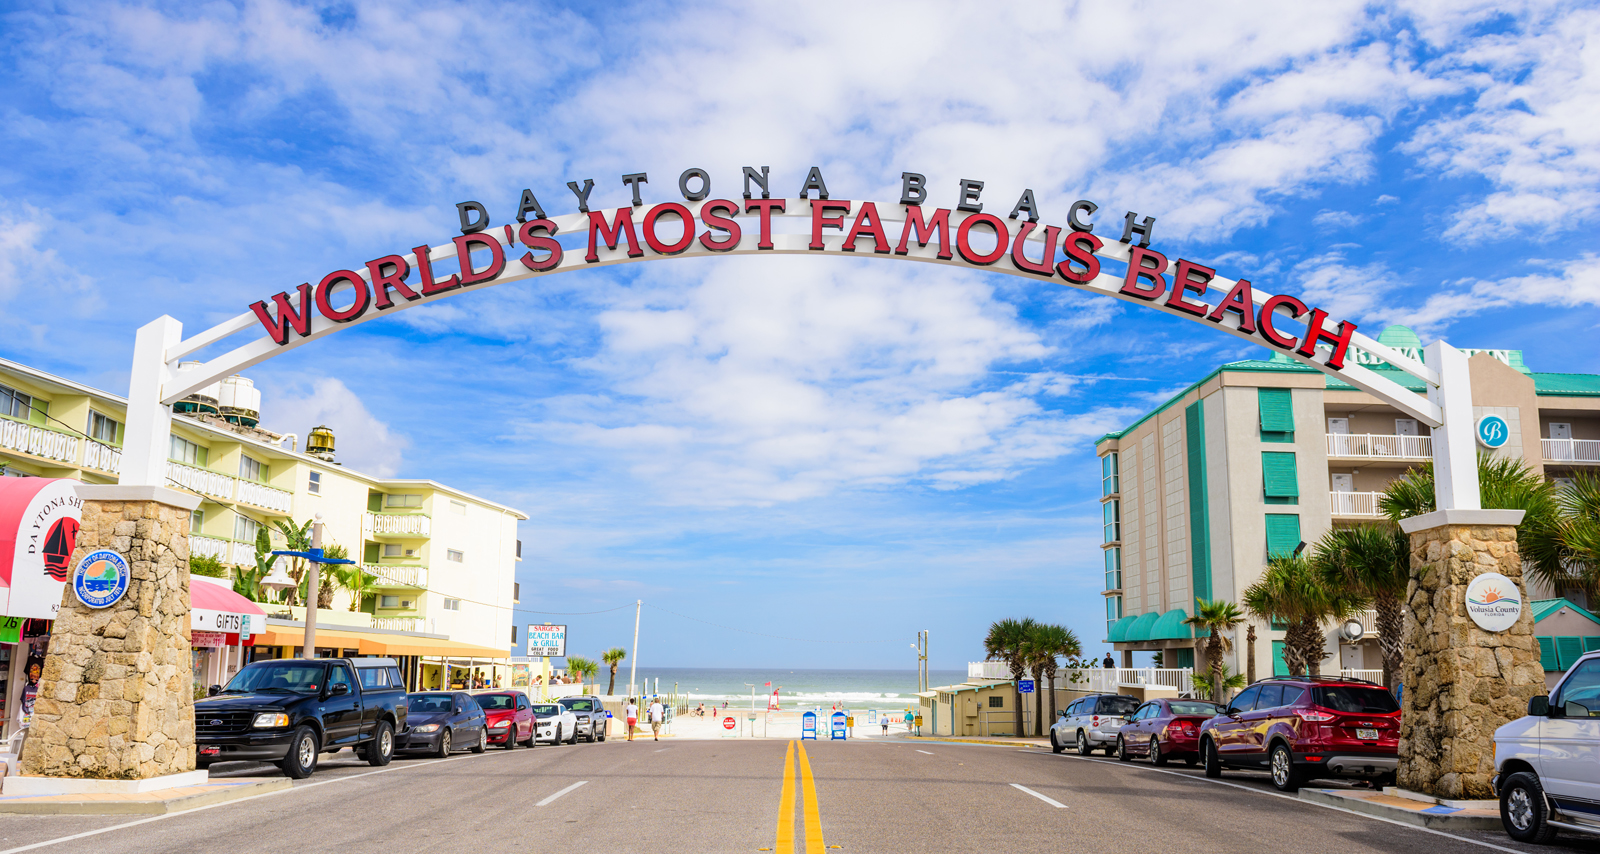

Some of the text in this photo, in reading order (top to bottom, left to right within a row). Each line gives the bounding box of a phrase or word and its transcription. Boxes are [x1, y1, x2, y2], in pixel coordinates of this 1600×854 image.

[455, 165, 1155, 248] DAYTONA BEACH
[248, 198, 1358, 371] WORLD'S MOST FAMOUS BEACH
[28, 495, 82, 555] DAYTONA SH
[99, 554, 118, 563] DAYTONA
[116, 561, 126, 577] BEACH
[78, 586, 104, 604] INCORPORATED
[105, 594, 115, 602] JULY
[1495, 606, 1519, 614] County
[216, 614, 240, 630] GIFTS
